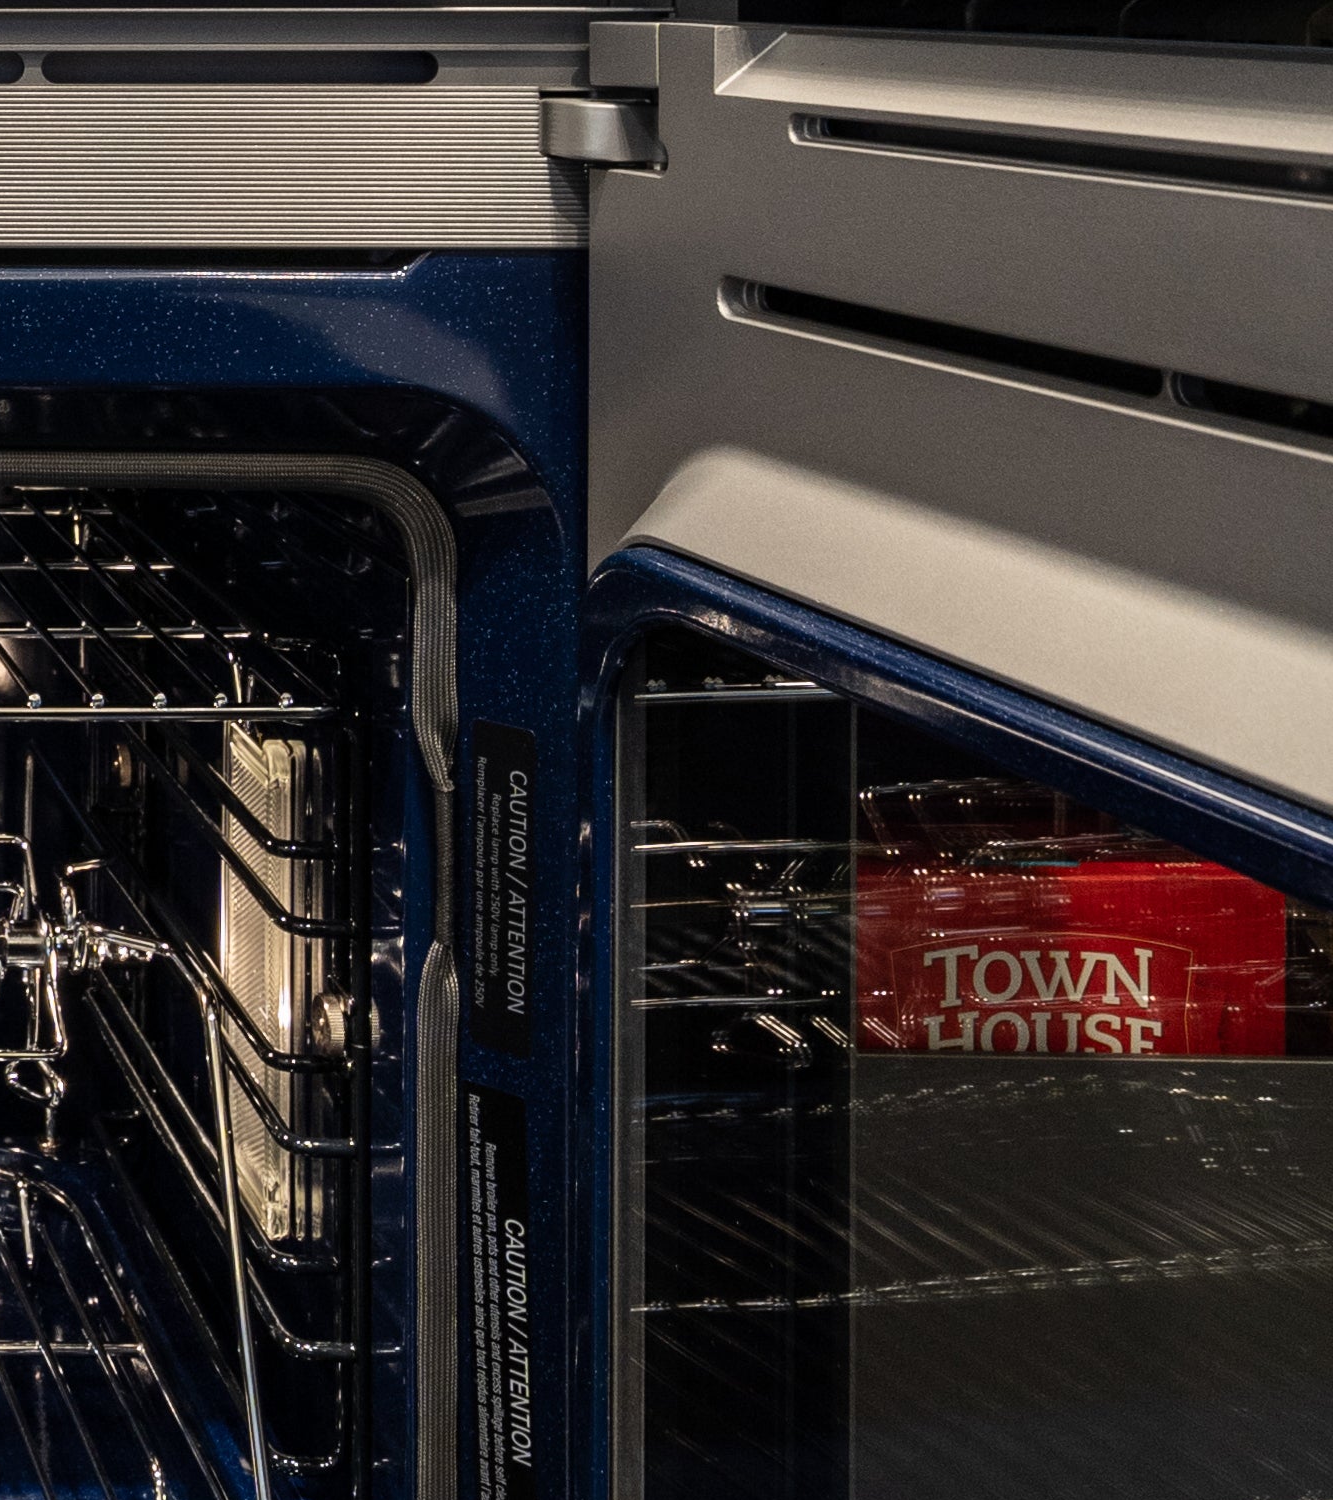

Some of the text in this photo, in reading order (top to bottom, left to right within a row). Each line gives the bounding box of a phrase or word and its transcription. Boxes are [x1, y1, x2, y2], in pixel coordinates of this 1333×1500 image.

[492, 793, 502, 866] Replace lamp
[509, 770, 527, 869] CAUTION
[507, 888, 526, 1014] ATTENTION
[924, 945, 1152, 1009] TOWN
[924, 1012, 1162, 1054] HOUSE
[504, 1218, 528, 1321] CAUTION
[508, 1337, 531, 1467] ATTENTION
